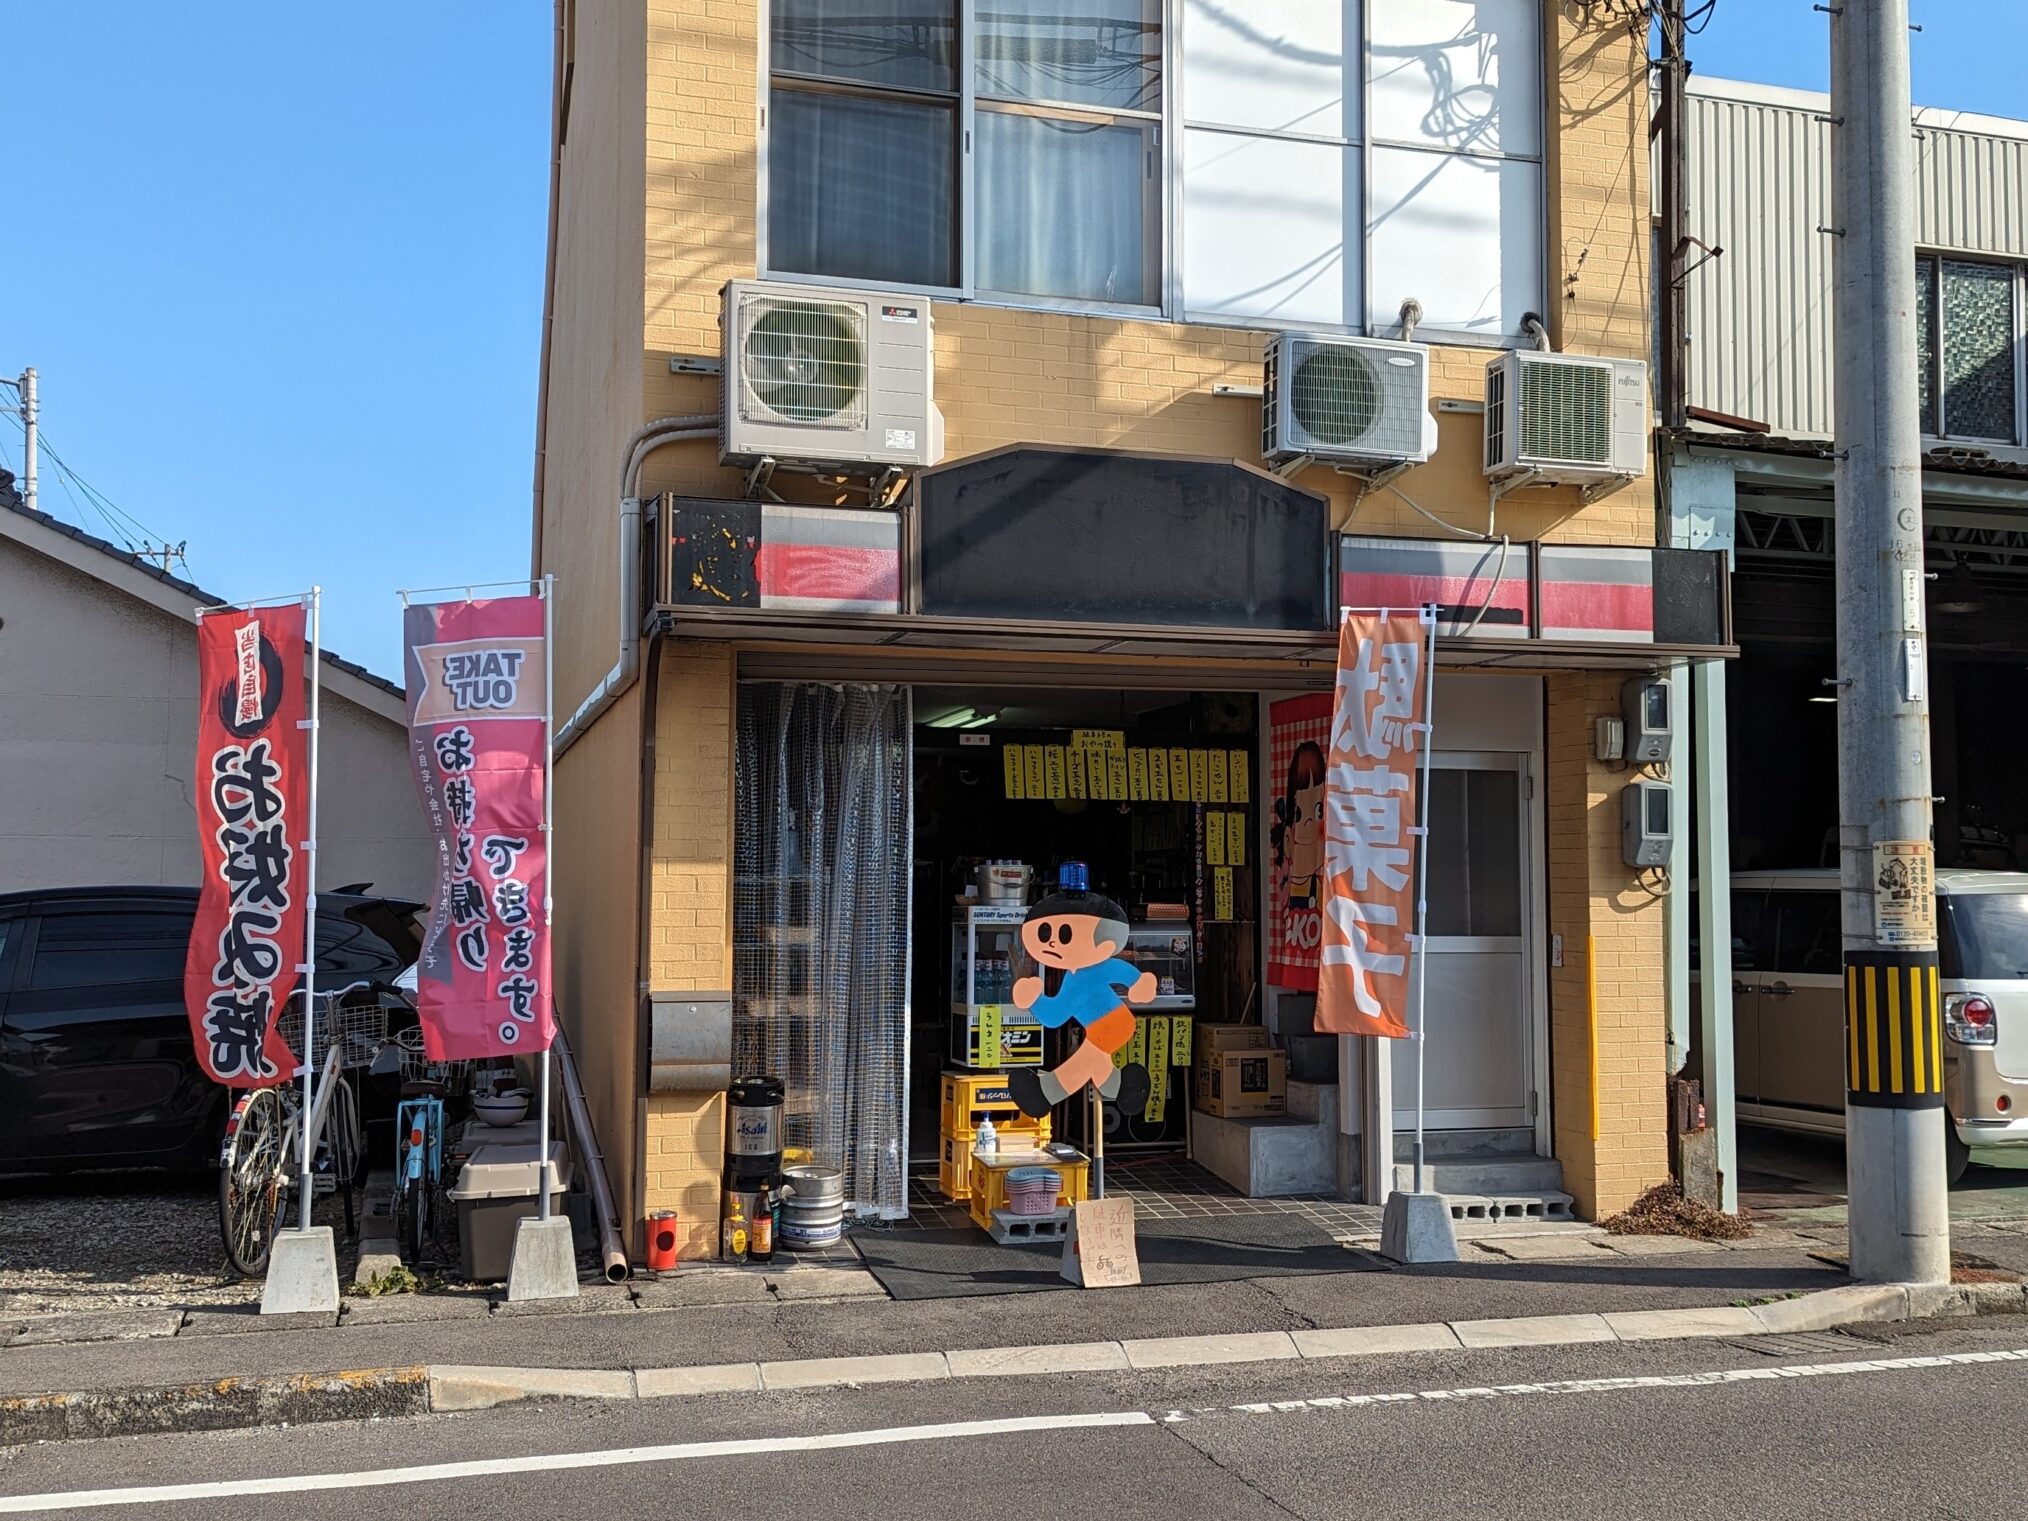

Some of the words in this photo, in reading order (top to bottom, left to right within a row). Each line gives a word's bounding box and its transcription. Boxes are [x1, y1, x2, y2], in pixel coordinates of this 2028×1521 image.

[1618, 375, 1640, 387] FUJITSU
[997, 911, 1014, 919] Sports
[737, 1122, 768, 1136] Asahi
